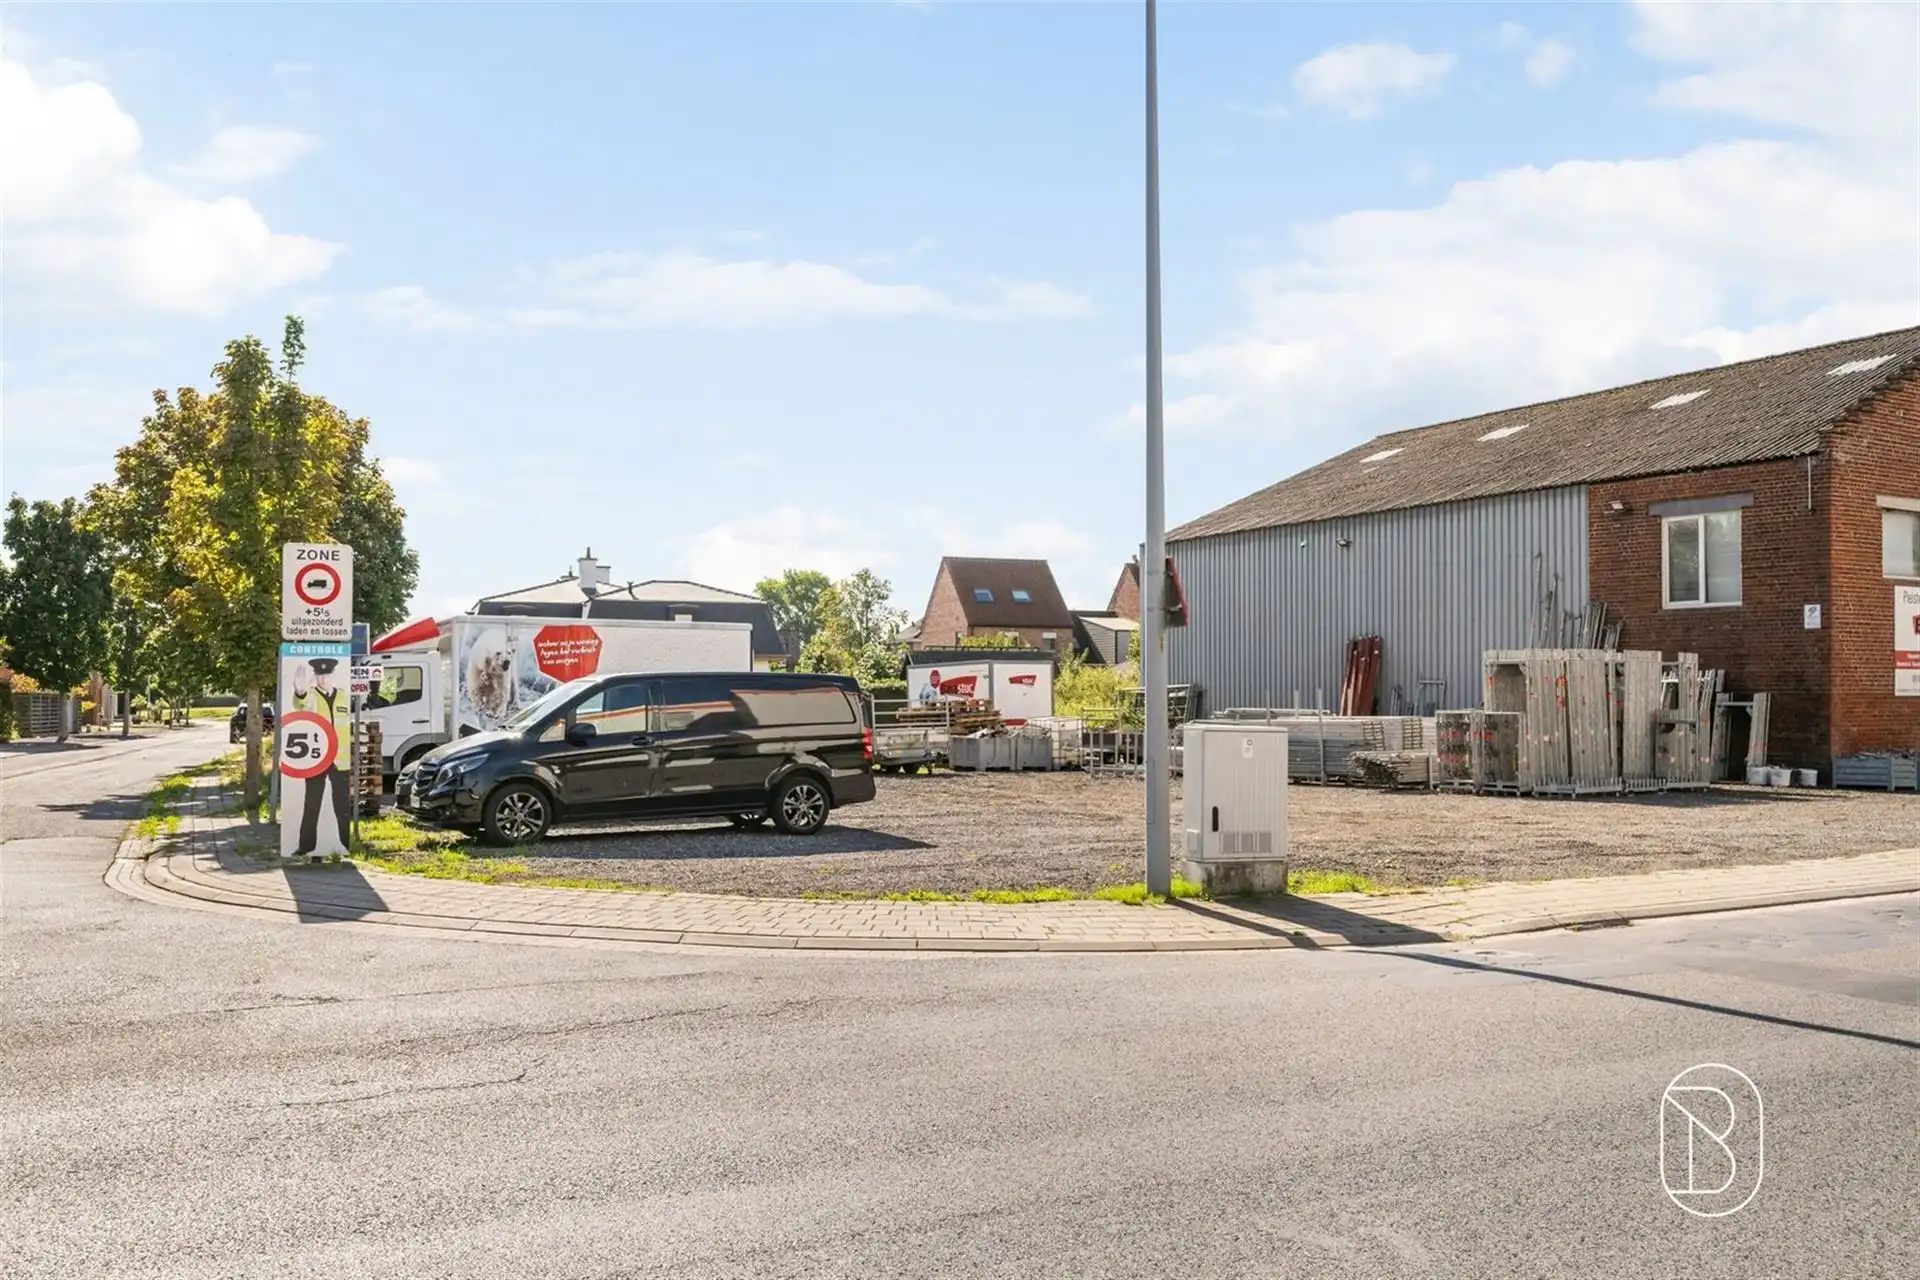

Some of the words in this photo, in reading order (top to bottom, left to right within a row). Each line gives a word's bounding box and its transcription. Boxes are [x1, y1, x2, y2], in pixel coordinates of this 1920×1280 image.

[296, 549, 340, 561] ZONE
[291, 617, 343, 626] uitgezonderd
[287, 627, 308, 636] laden
[322, 627, 348, 636] lossen
[290, 645, 343, 655] CONTROLE
